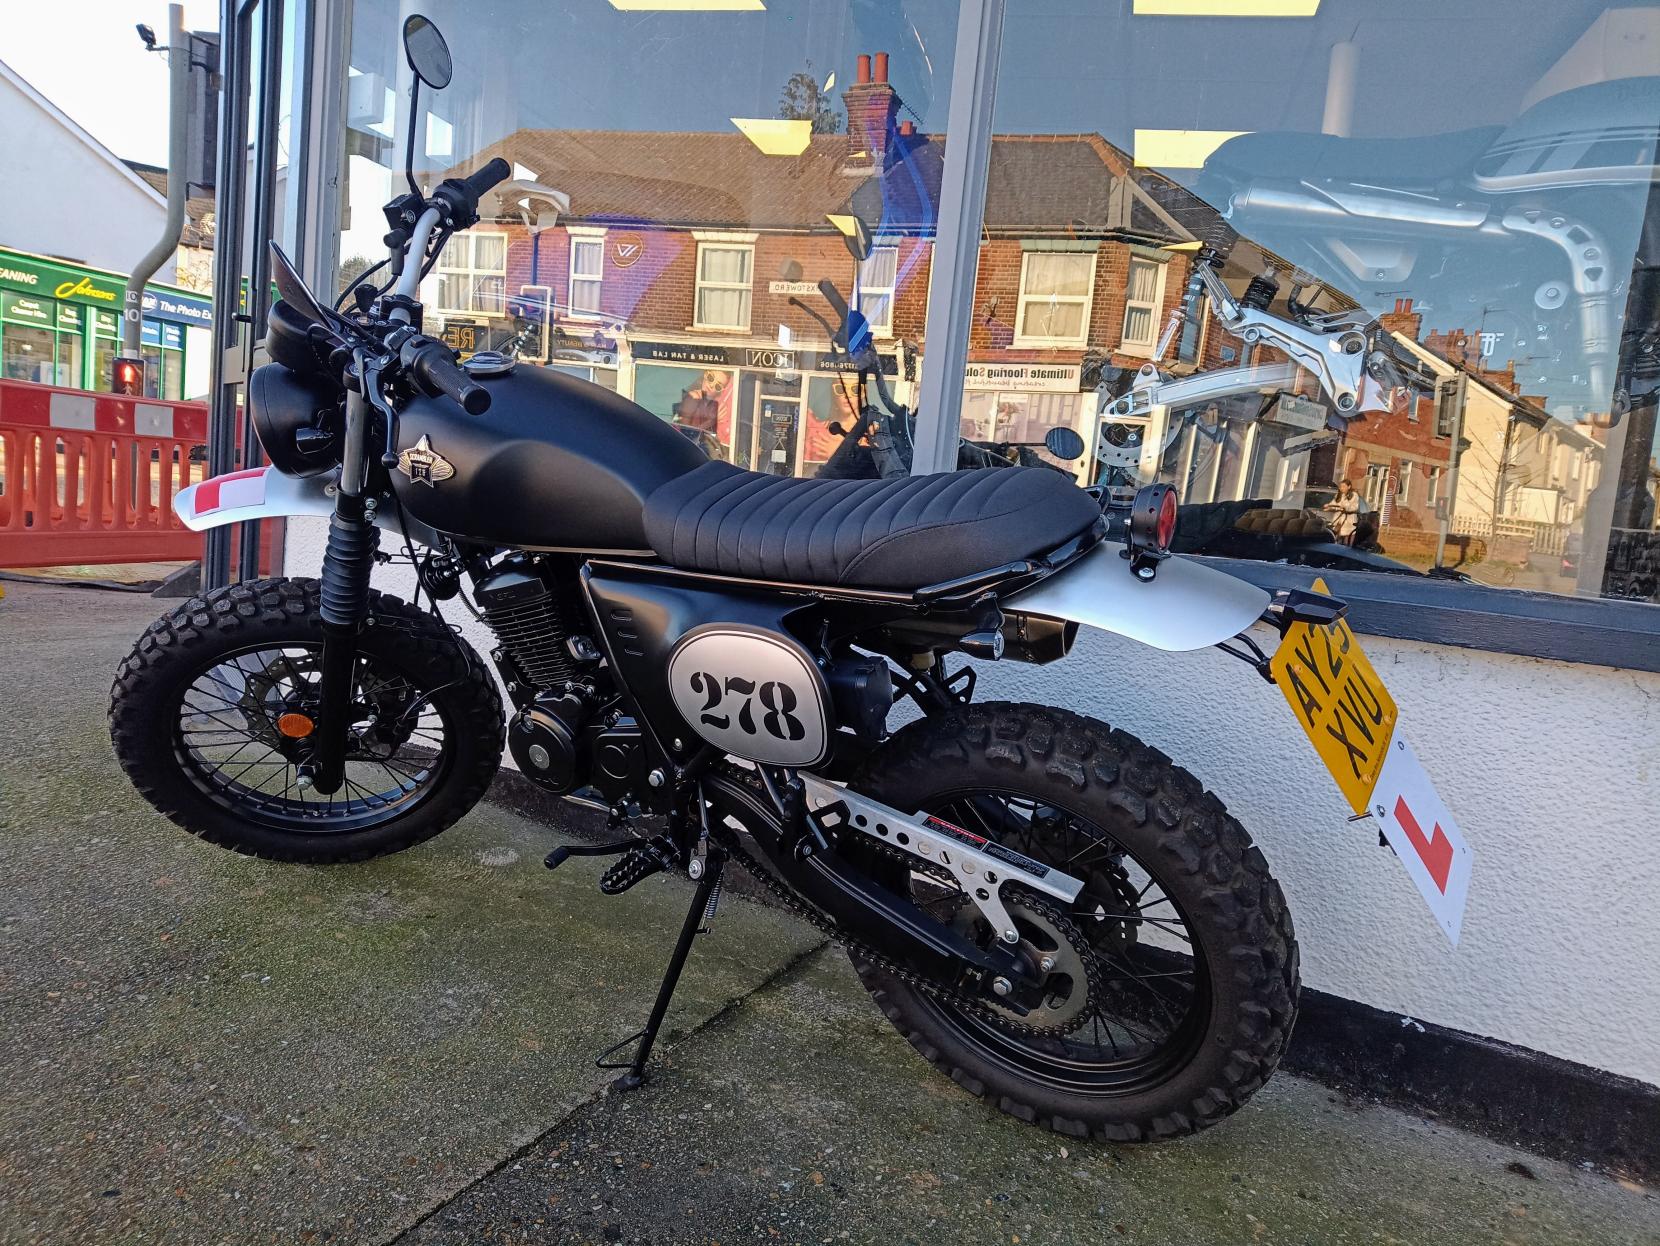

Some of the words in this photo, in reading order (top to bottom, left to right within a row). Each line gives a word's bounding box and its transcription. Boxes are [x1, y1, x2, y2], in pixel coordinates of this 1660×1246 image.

[124, 308, 139, 322] 10
[160, 301, 176, 313] The
[177, 304, 201, 317] Photo
[690, 671, 806, 741] 278
[1326, 663, 1383, 780] XVU
[1393, 793, 1454, 897] L
